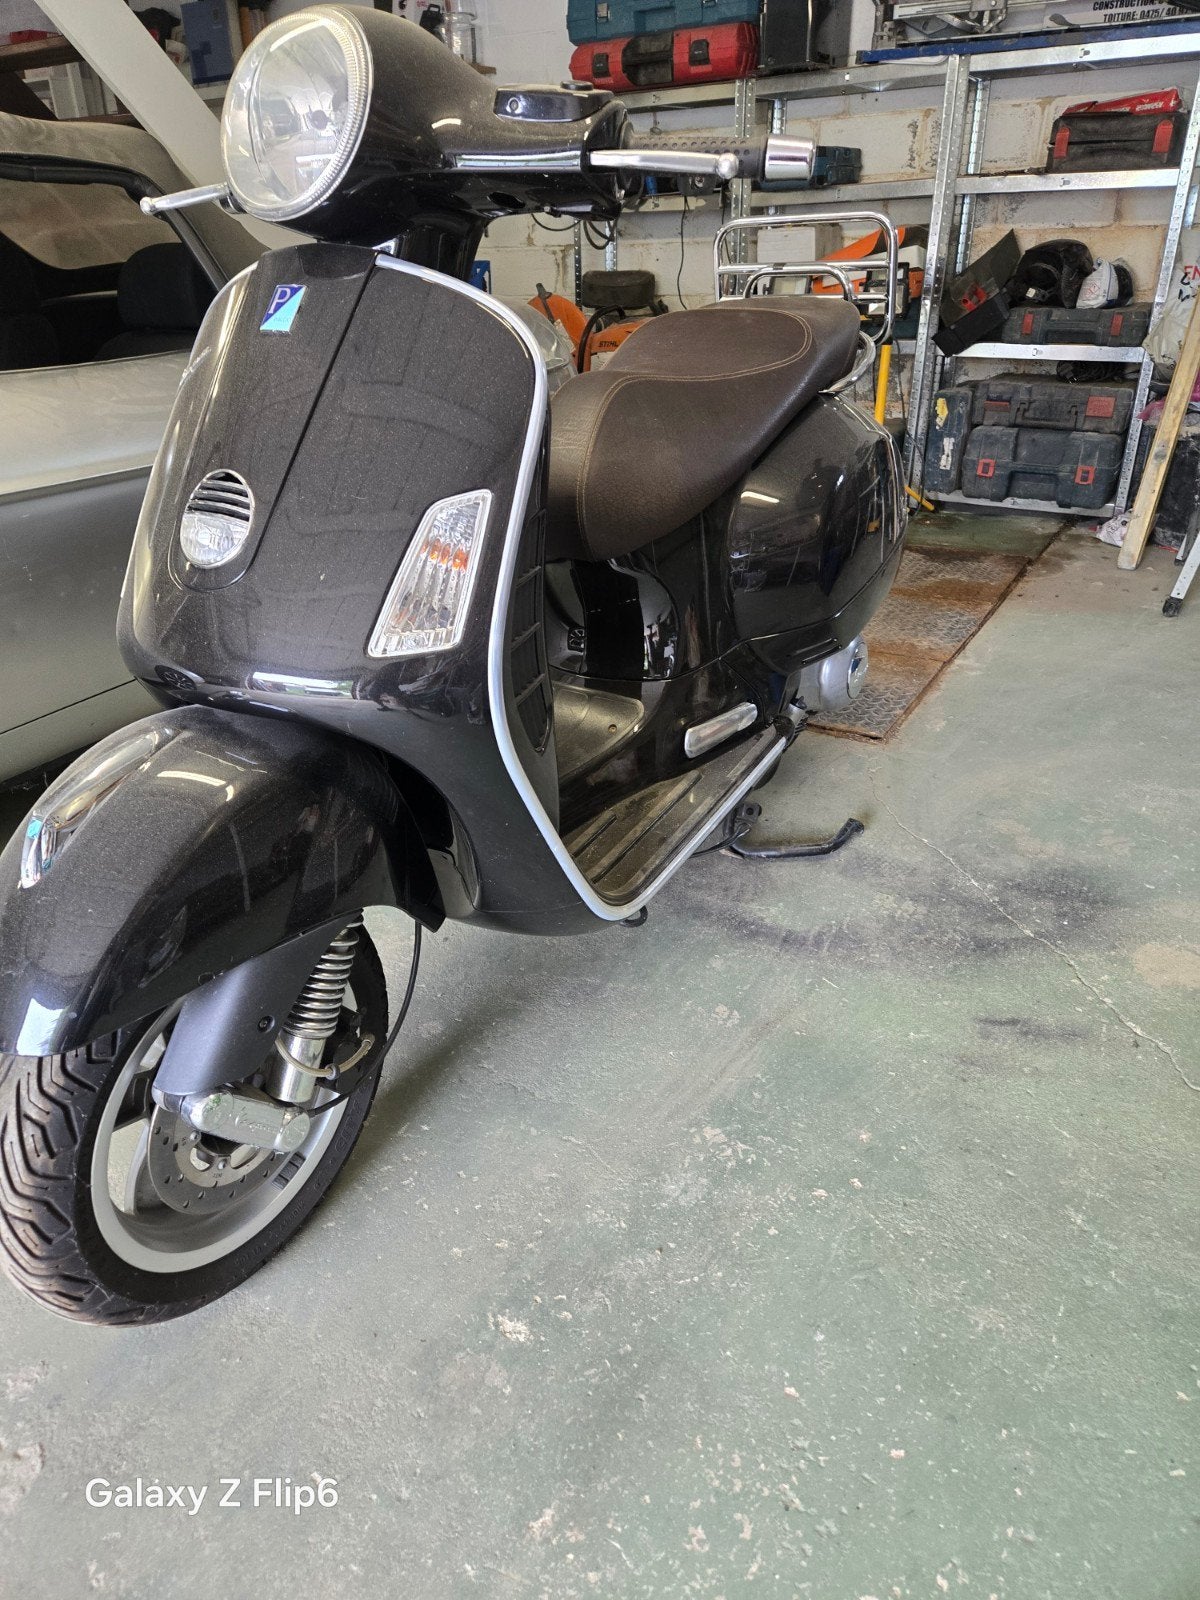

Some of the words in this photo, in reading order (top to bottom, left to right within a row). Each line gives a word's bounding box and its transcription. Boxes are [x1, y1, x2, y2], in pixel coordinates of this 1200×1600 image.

[1103, 11, 1138, 23] TOITURE:
[267, 287, 291, 314] P
[598, 340, 618, 348] STIHL
